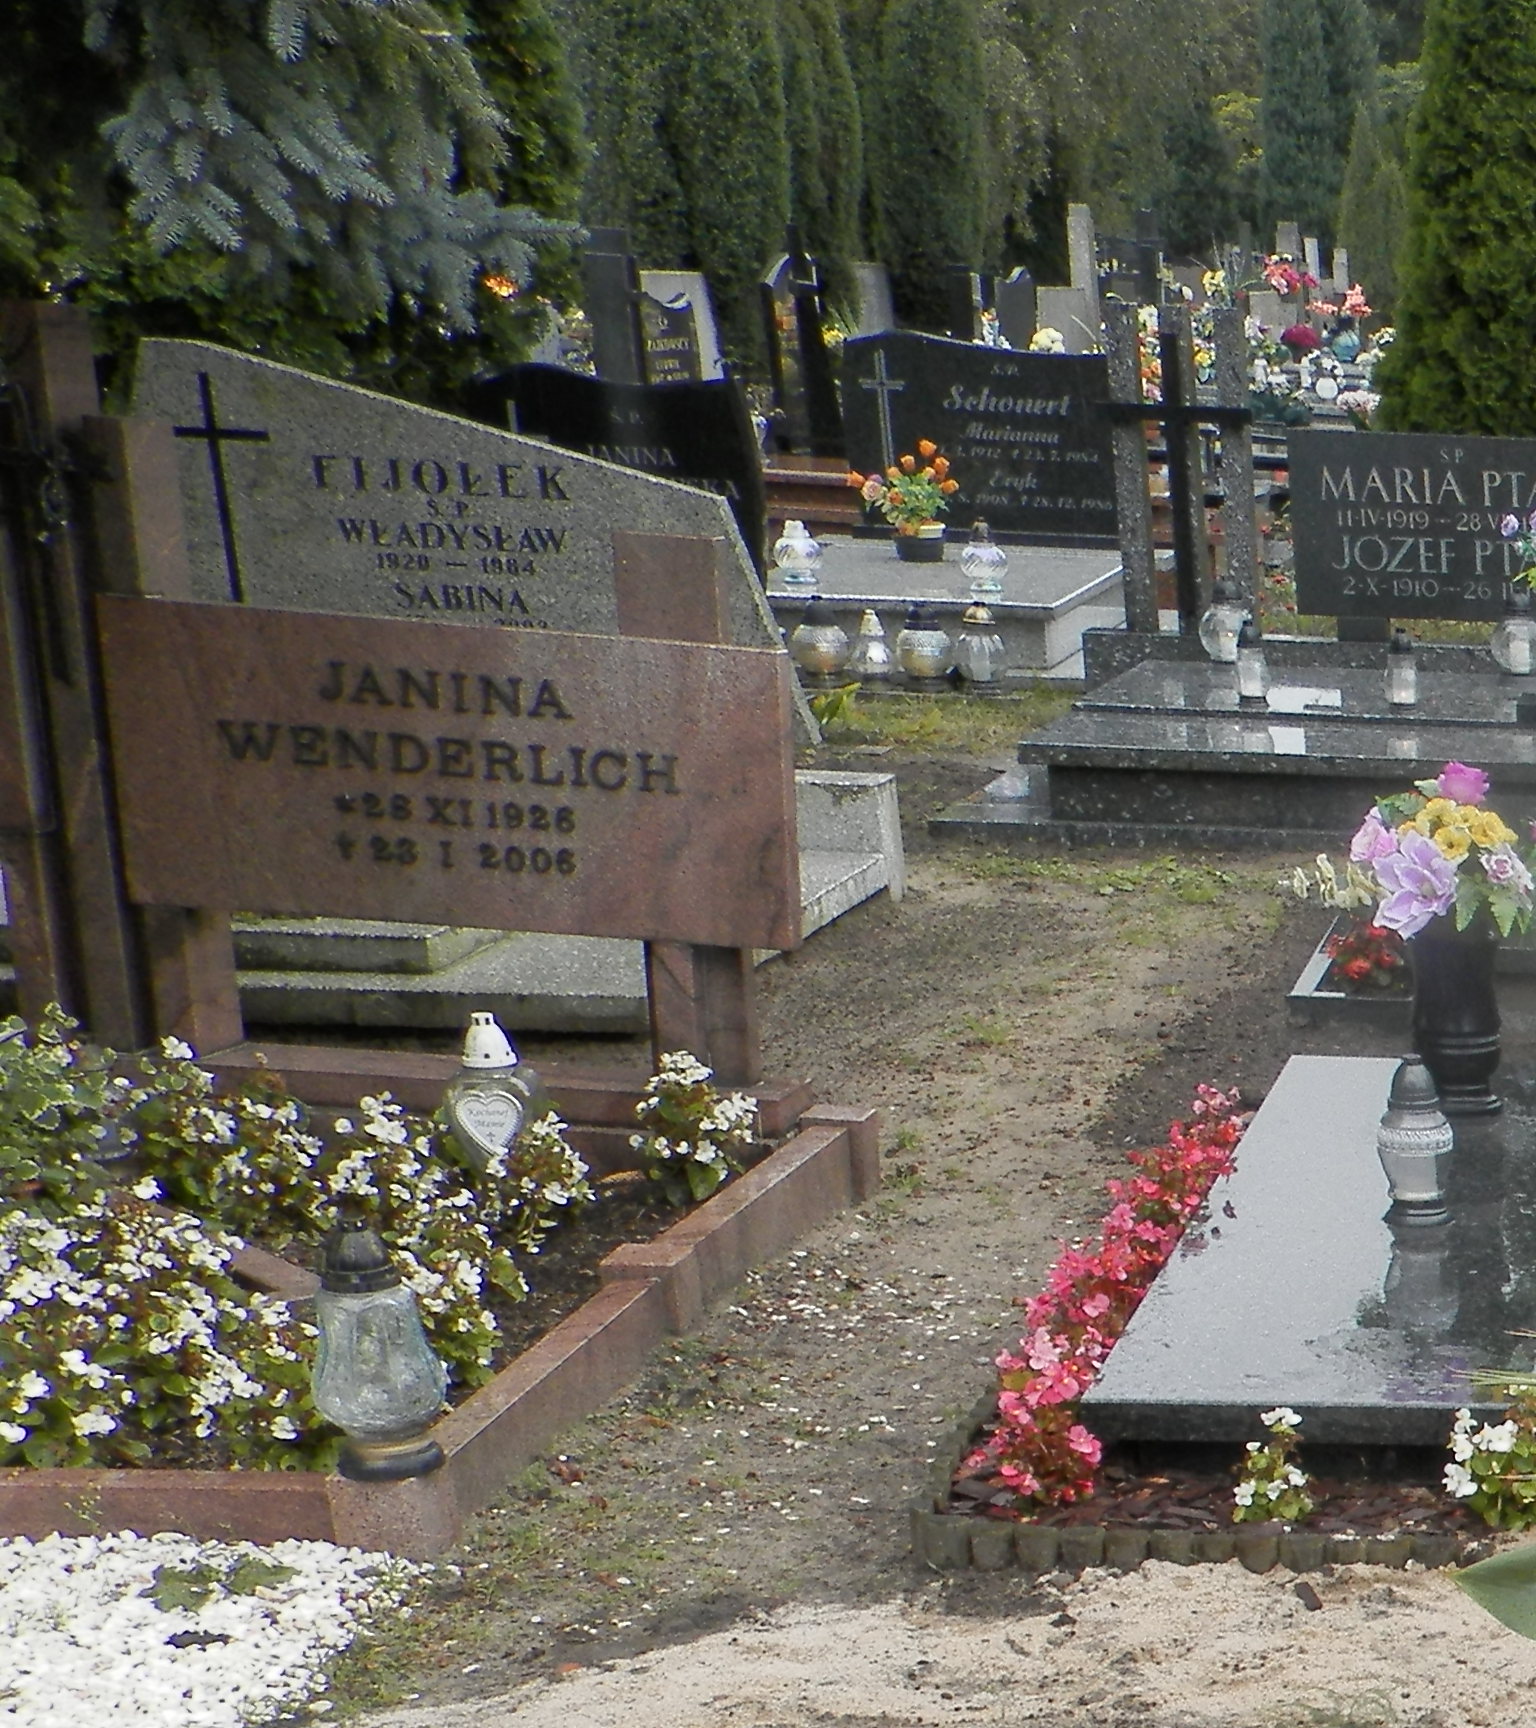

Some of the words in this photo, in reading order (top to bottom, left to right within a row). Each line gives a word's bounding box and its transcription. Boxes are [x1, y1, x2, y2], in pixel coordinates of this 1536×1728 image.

[1320, 466, 1466, 506] MARIA
[337, 518, 567, 553] WŁADYSŁAW
[392, 582, 530, 615] SABINA
[319, 660, 574, 720] JANINA
[216, 718, 680, 795] WENDERLICH
[486, 801, 577, 834] 1926
[478, 841, 578, 875] 2006
